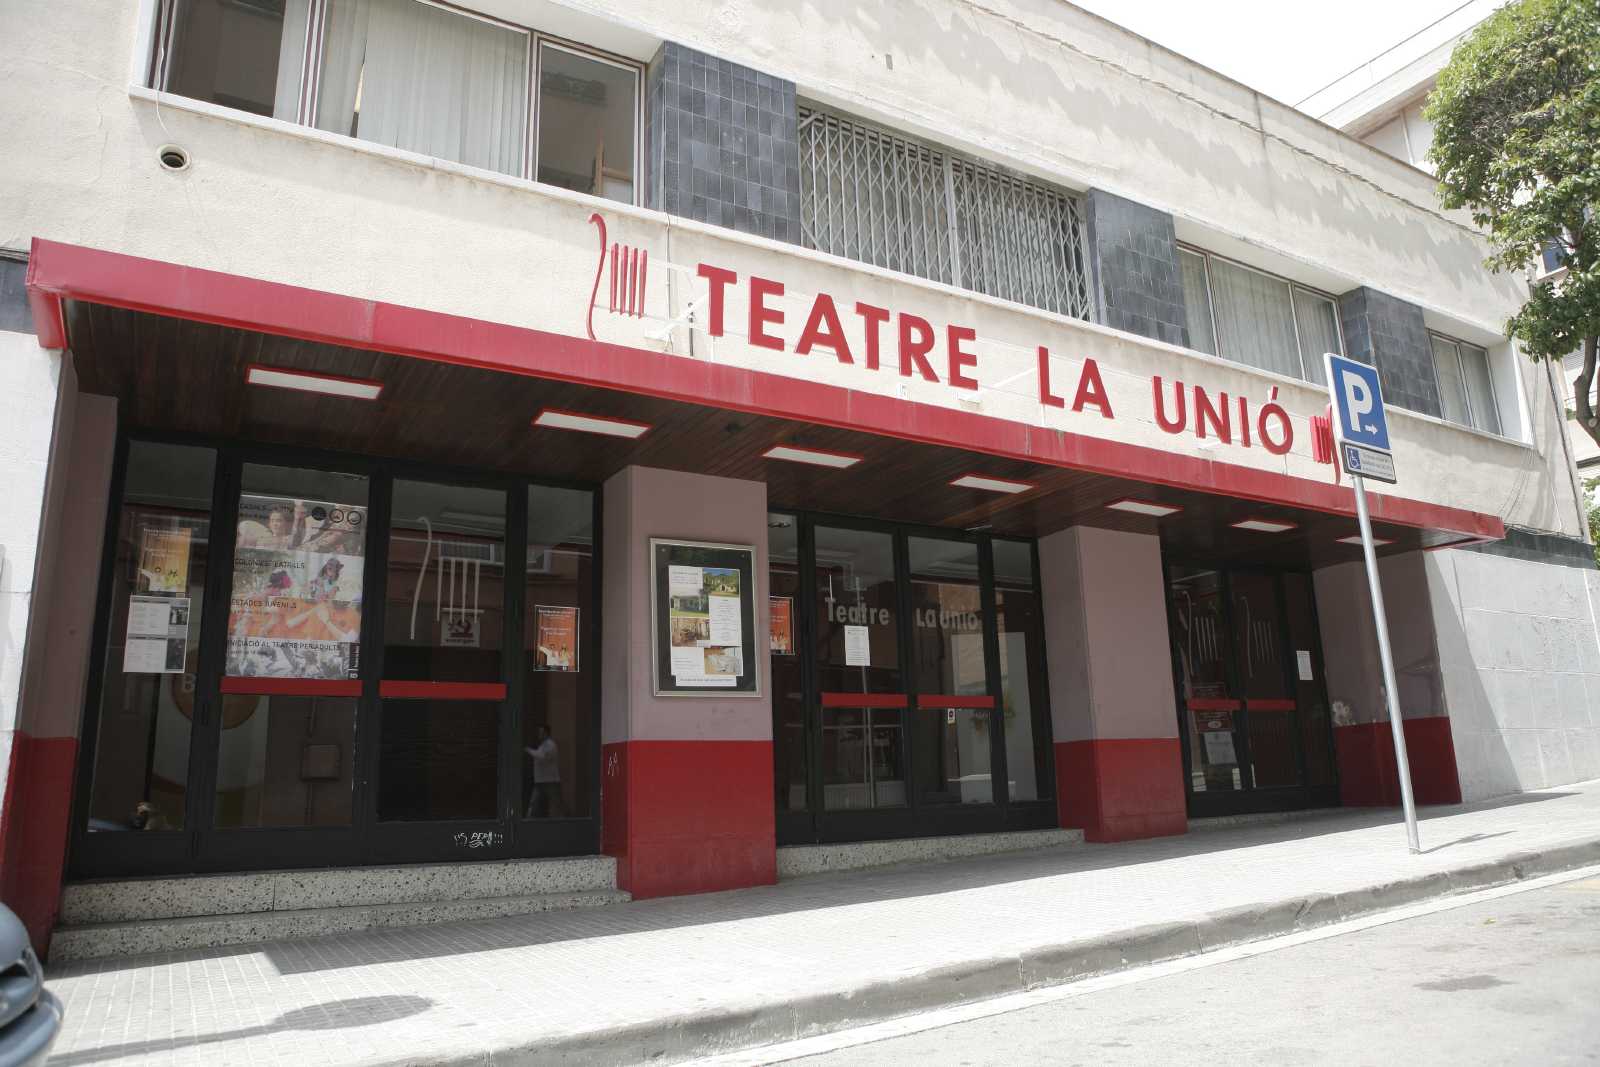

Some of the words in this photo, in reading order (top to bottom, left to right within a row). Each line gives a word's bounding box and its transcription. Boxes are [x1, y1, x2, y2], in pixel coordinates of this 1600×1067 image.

[698, 264, 978, 390] TEATRE
[1037, 346, 1113, 418] LA
[1152, 376, 1293, 454] UNIÓ
[1342, 370, 1373, 433] P
[824, 597, 889, 625] Teatre
[916, 607, 937, 628] La
